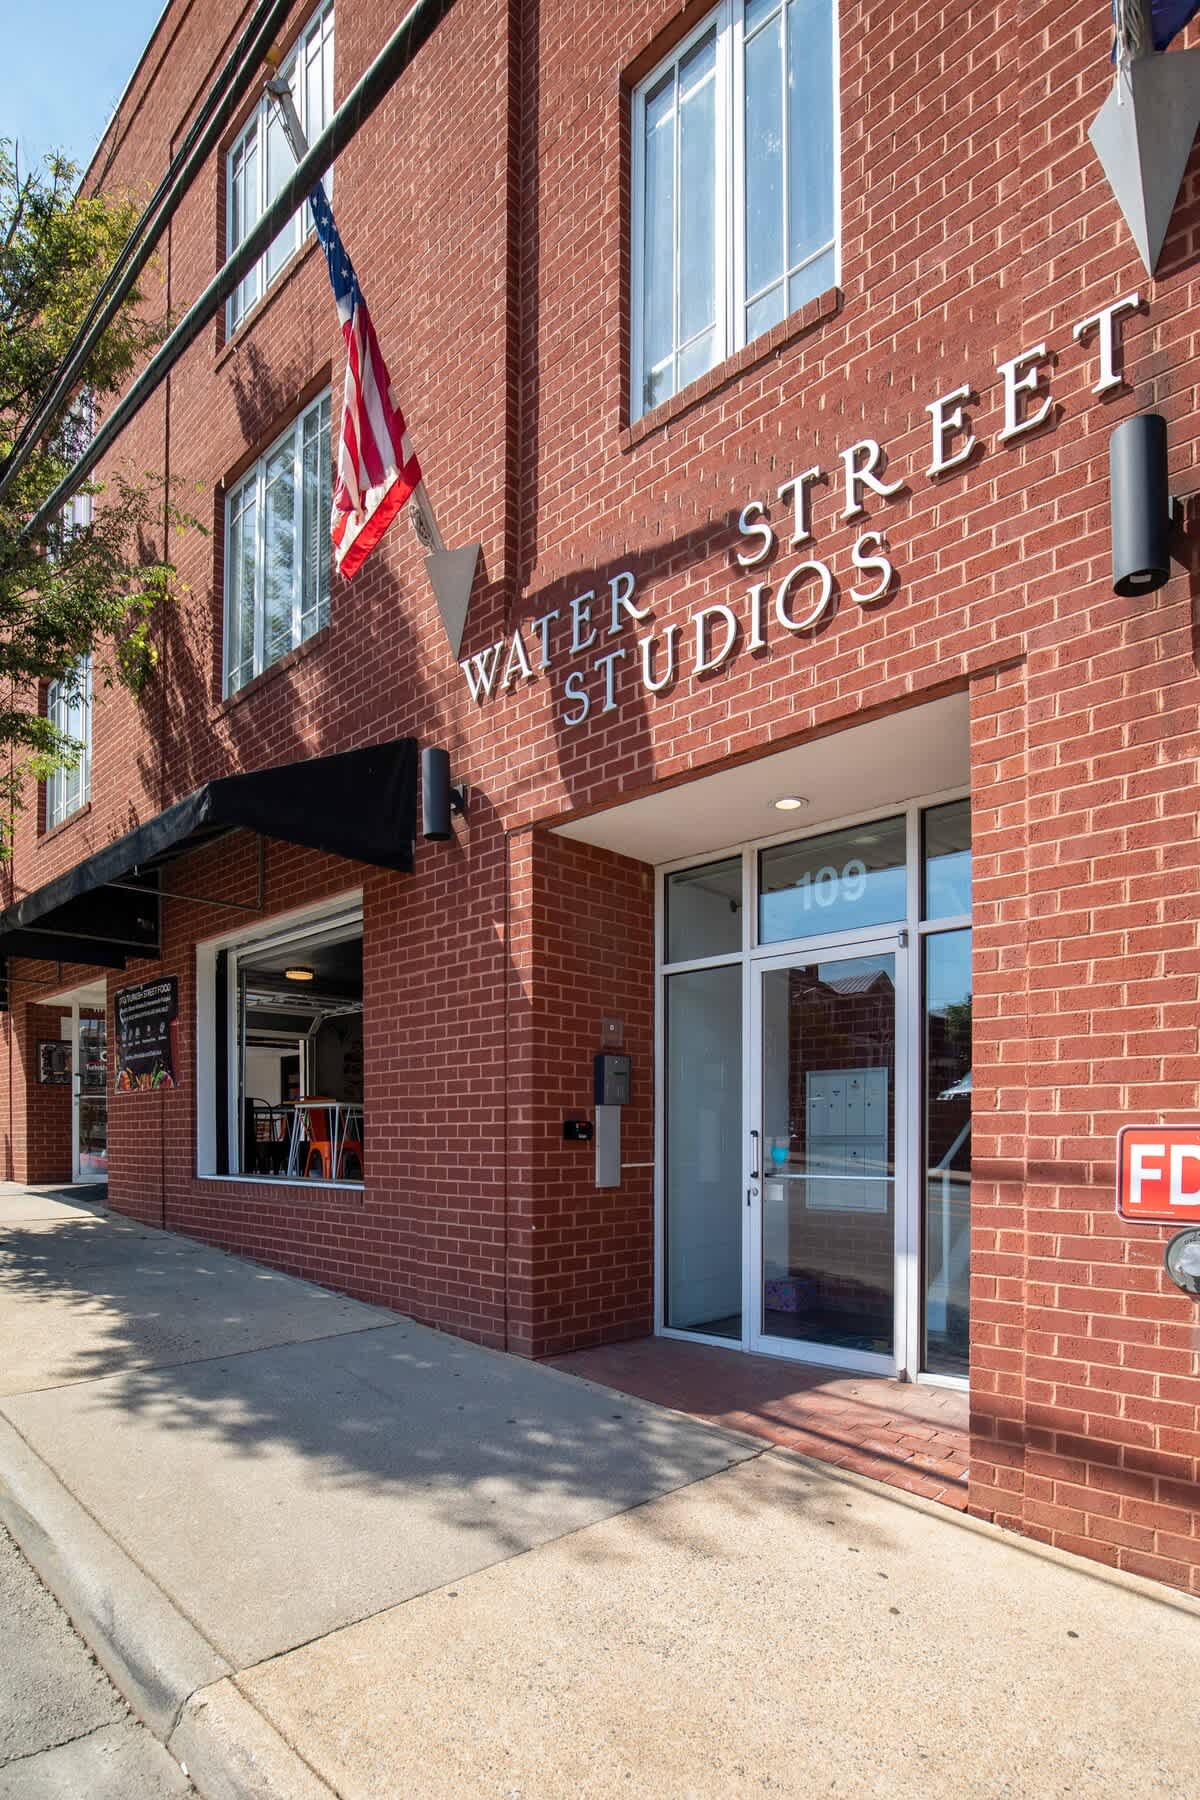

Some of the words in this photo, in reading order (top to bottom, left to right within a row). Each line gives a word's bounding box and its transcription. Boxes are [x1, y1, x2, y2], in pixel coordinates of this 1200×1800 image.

[459, 570, 653, 703] WATER
[735, 291, 1141, 567] STREET
[561, 531, 894, 727] STUDIOS
[795, 859, 867, 911] 109
[143, 987, 157, 998] STREET
[157, 983, 171, 993] FOOD
